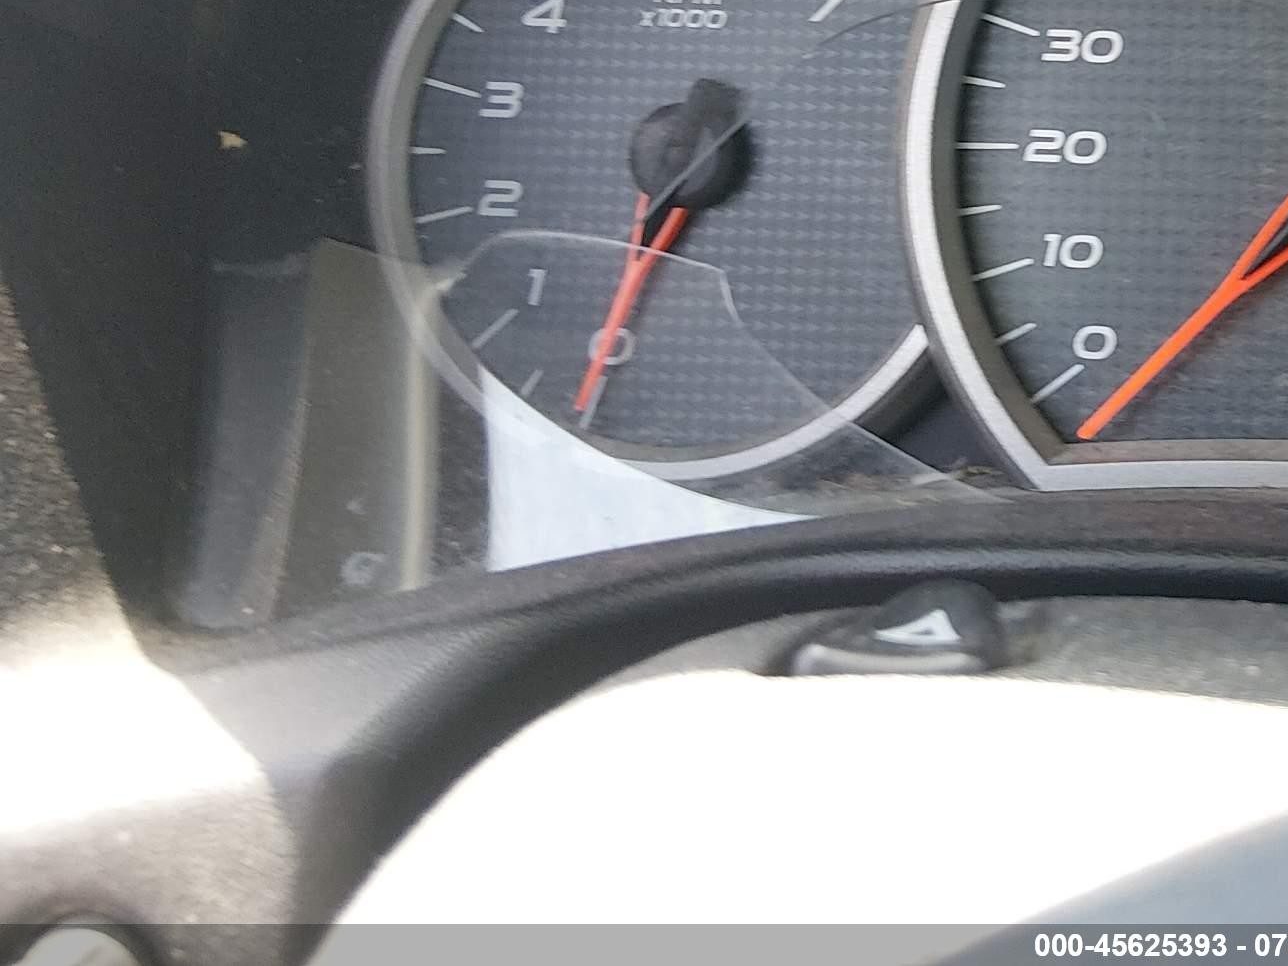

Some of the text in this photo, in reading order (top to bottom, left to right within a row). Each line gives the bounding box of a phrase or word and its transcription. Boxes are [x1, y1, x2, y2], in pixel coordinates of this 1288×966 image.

[1041, 30, 1124, 64] 30
[478, 80, 524, 119] 3
[1023, 129, 1107, 165] 20
[477, 179, 523, 218] 2
[1041, 234, 1104, 269] 10
[525, 267, 548, 307] 1
[588, 325, 635, 366] 0
[1072, 327, 1118, 360] 0
